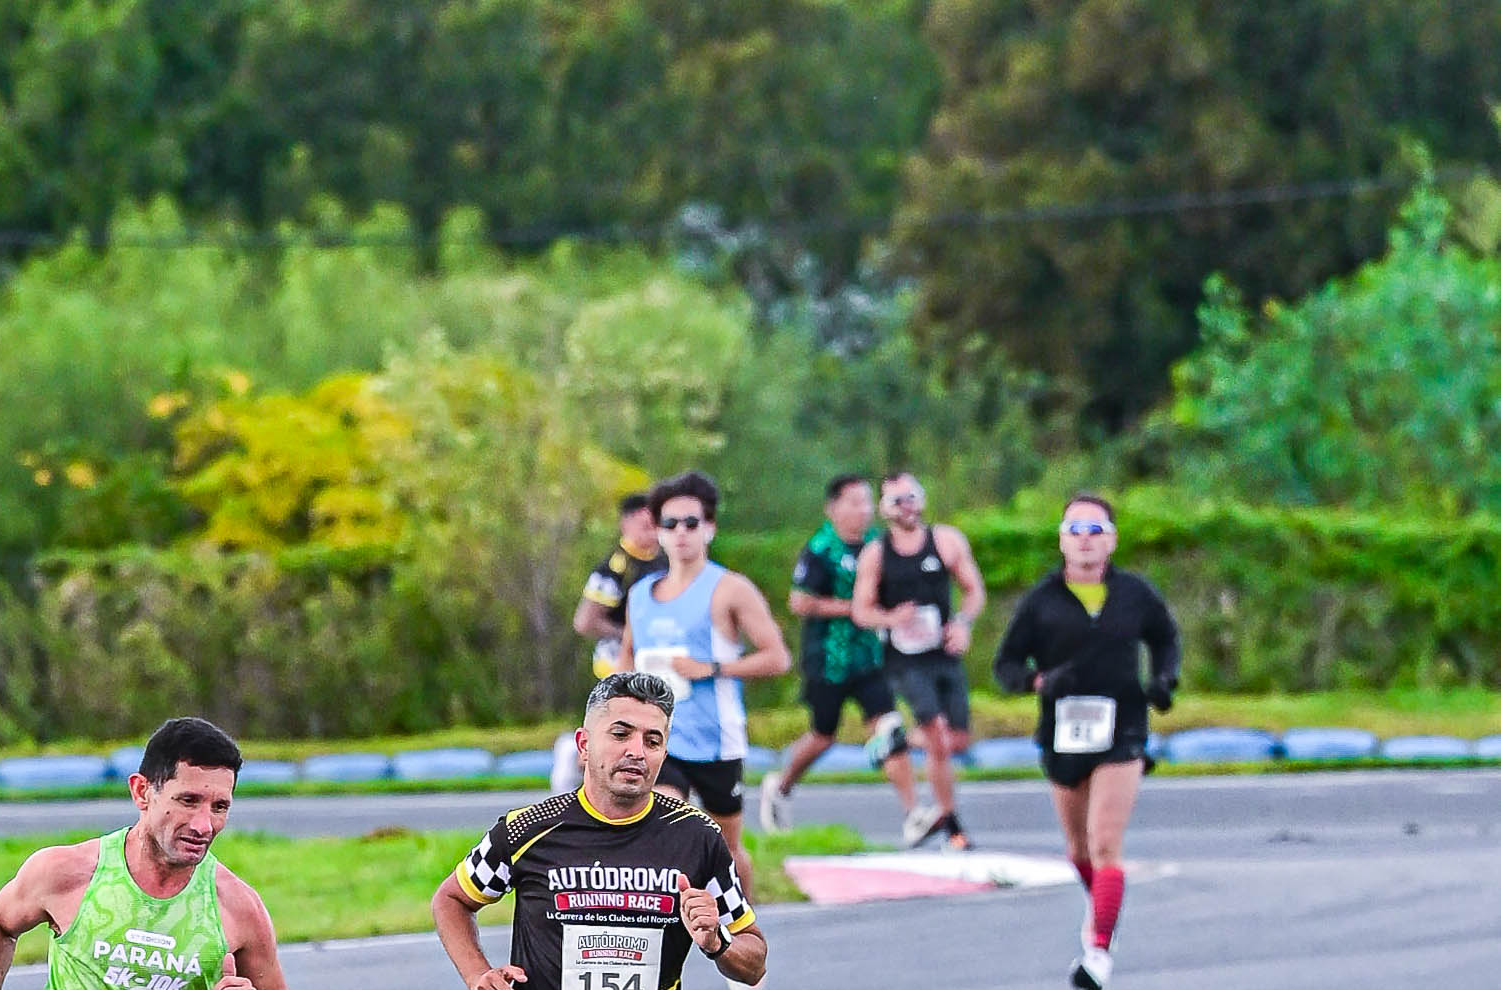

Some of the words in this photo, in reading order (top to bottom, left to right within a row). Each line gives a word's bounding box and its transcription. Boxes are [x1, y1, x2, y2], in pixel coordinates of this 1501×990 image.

[547, 861, 681, 893] AUTÓDROMO
[568, 893, 625, 908] RUNNING
[627, 894, 662, 910] RACE
[555, 912, 583, 921] Carrera
[584, 913, 596, 921] de
[597, 913, 607, 921] los
[608, 914, 635, 923] Clubes
[636, 915, 649, 923] del
[93, 940, 202, 976] PARANÁ
